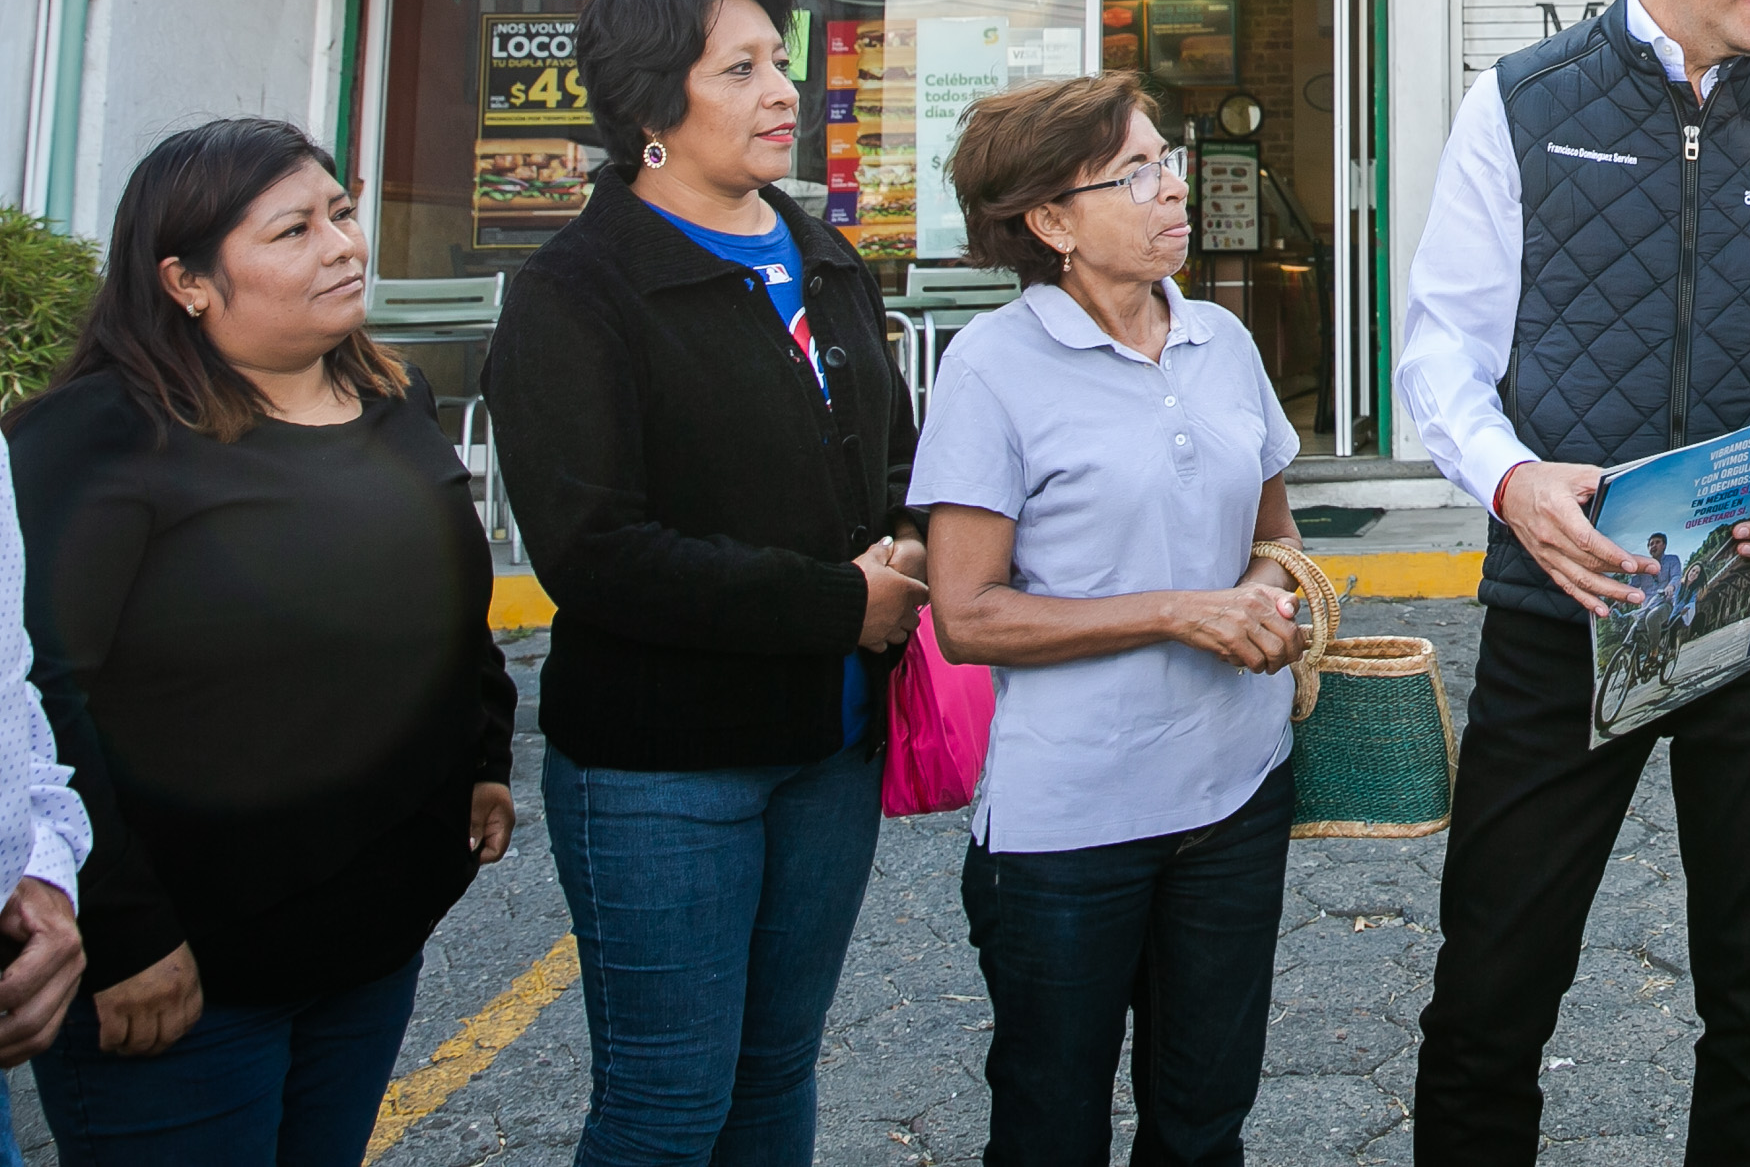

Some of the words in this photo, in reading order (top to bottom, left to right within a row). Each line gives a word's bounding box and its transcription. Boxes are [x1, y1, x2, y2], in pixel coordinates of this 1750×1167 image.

[492, 35, 578, 58] LOCO
[924, 73, 999, 87] Celébrate
[924, 89, 968, 103] todos
[924, 105, 956, 119] días
[1547, 141, 1579, 157] Francisco
[1713, 451, 1750, 471] VIVIMOS
[1693, 477, 1701, 487] Y
[1701, 471, 1720, 486] CON
[1691, 498, 1705, 508] EN
[1705, 488, 1740, 505] MÉXICO
[1696, 486, 1709, 497] LO
[1693, 501, 1730, 517] PORQUE
[1730, 497, 1745, 508] EN
